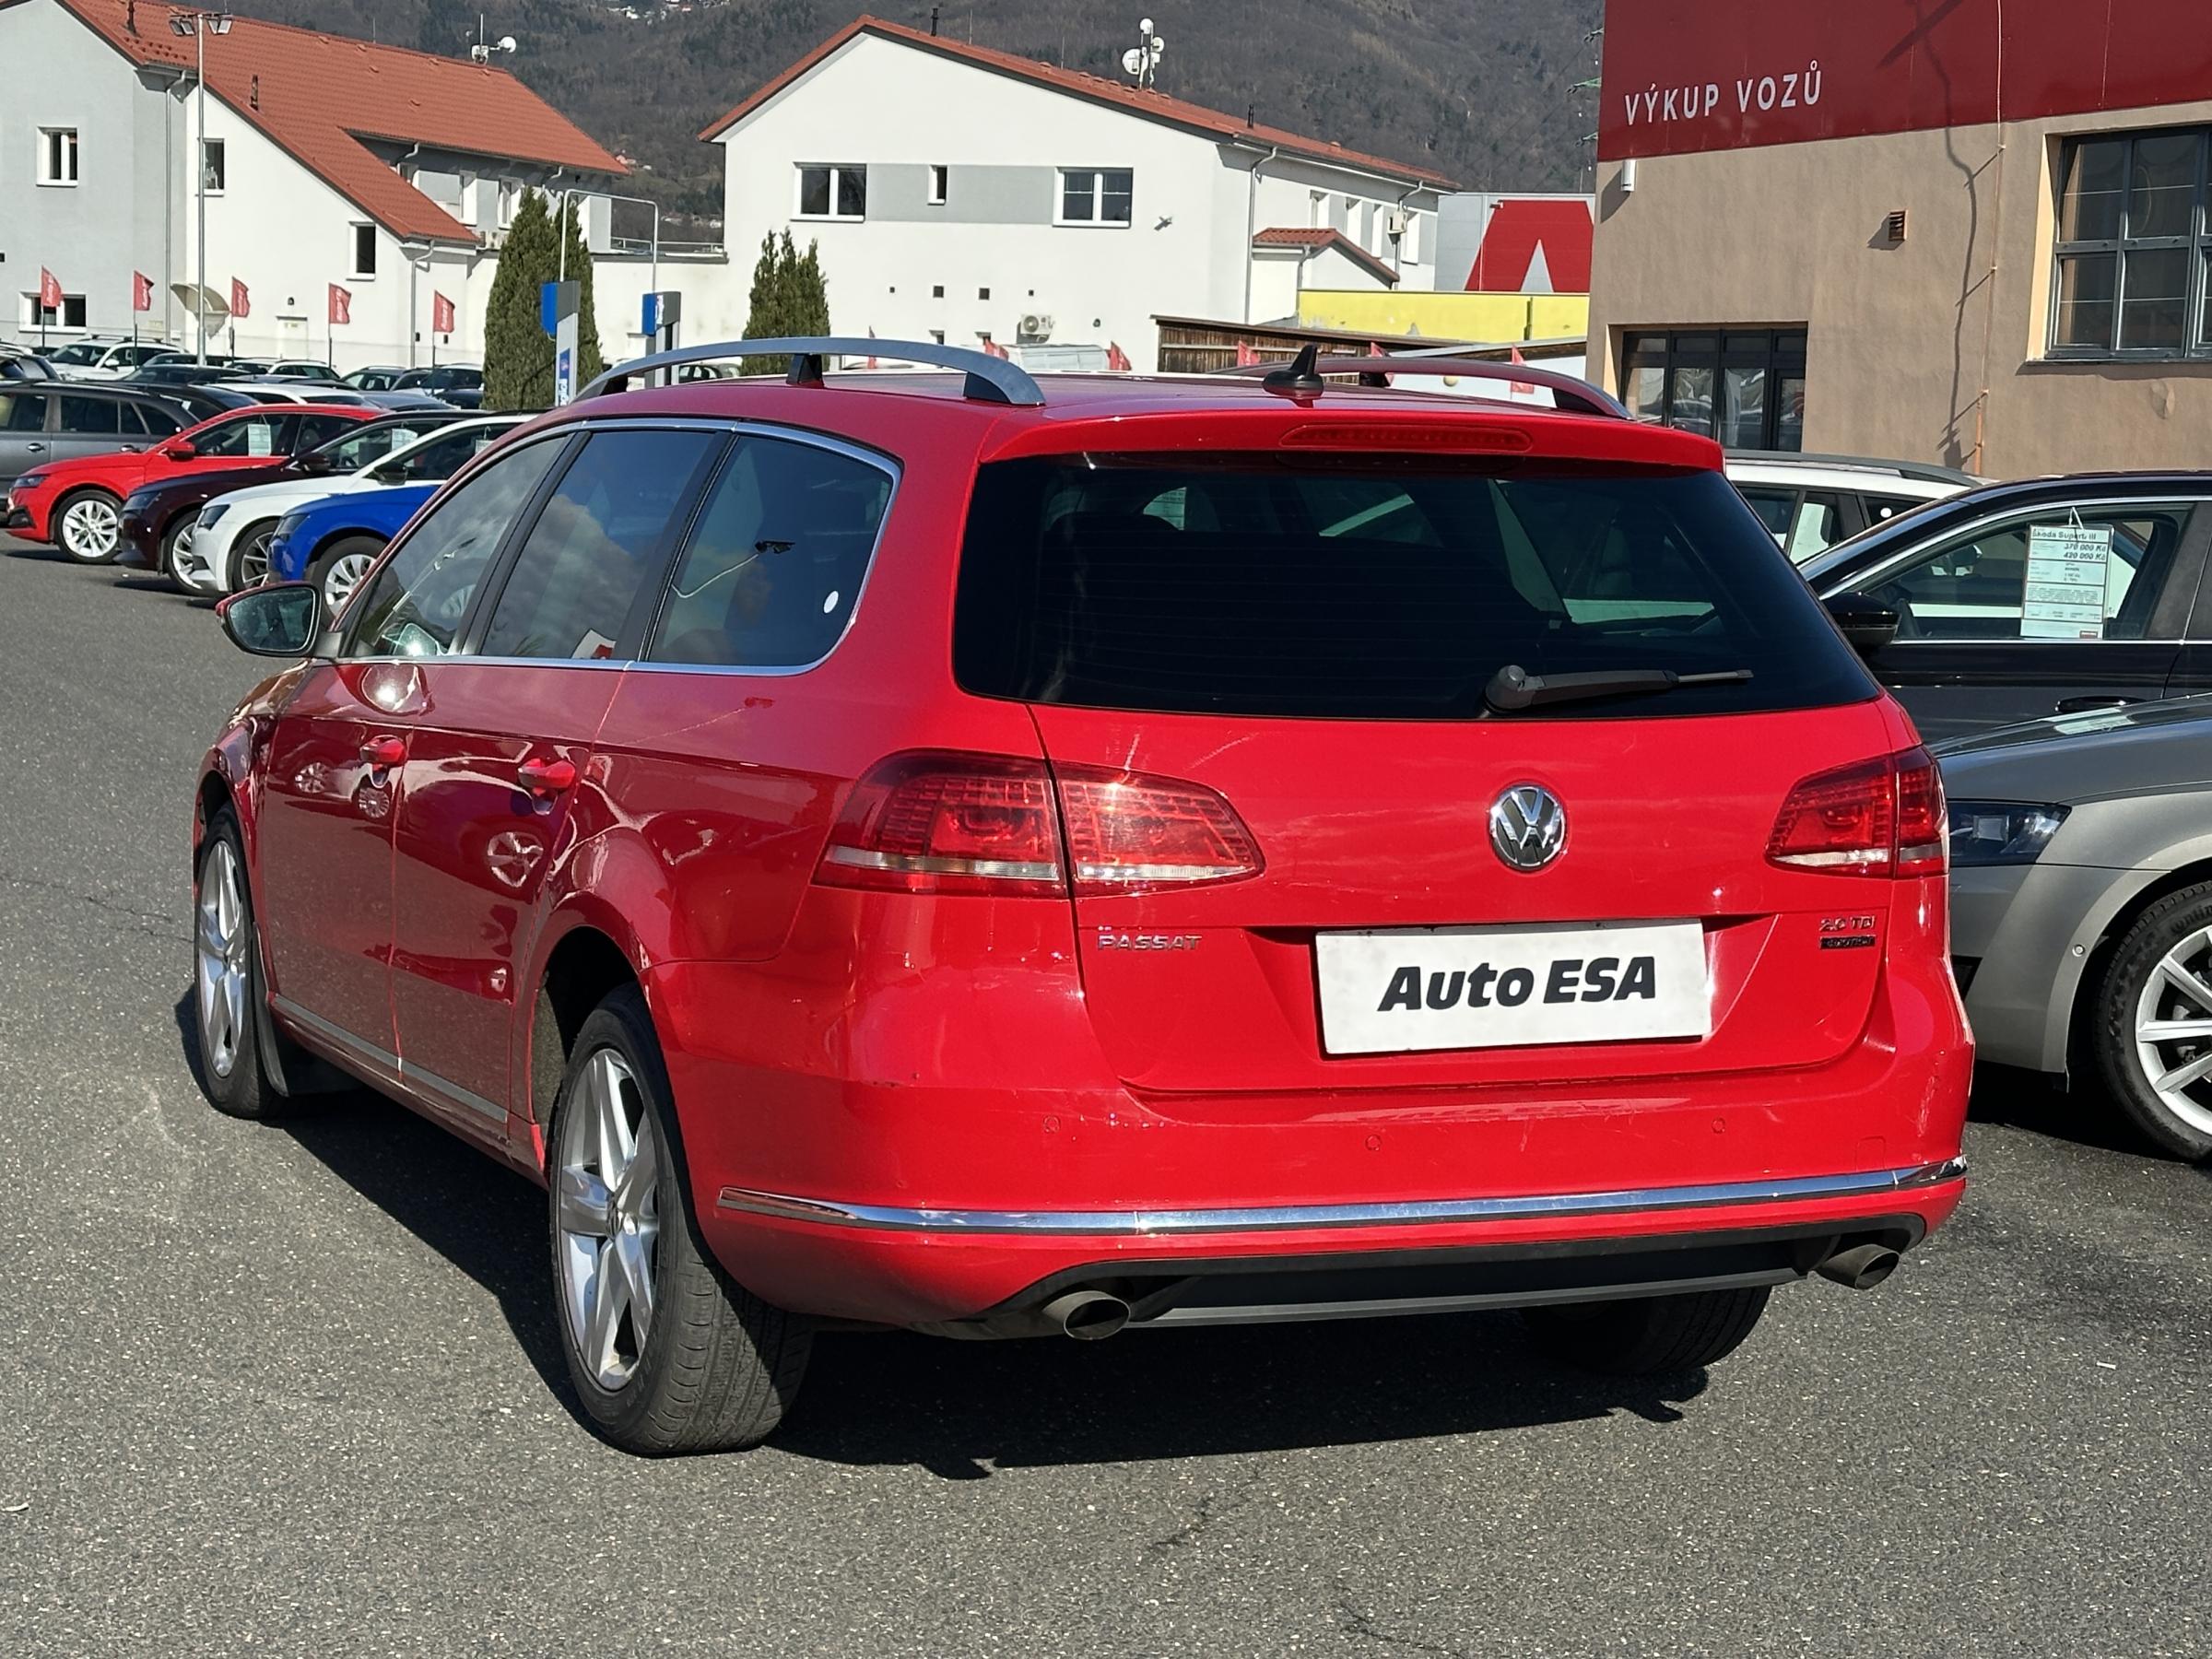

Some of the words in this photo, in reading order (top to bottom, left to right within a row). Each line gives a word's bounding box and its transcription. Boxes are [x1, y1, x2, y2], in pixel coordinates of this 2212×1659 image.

[1624, 82, 1720, 126] VÝKUP
[1735, 59, 1822, 113] VOZŮ
[1098, 935, 1203, 950] PASSAT
[1377, 962, 1535, 1012] Auto
[1543, 956, 1655, 1005] ESA
